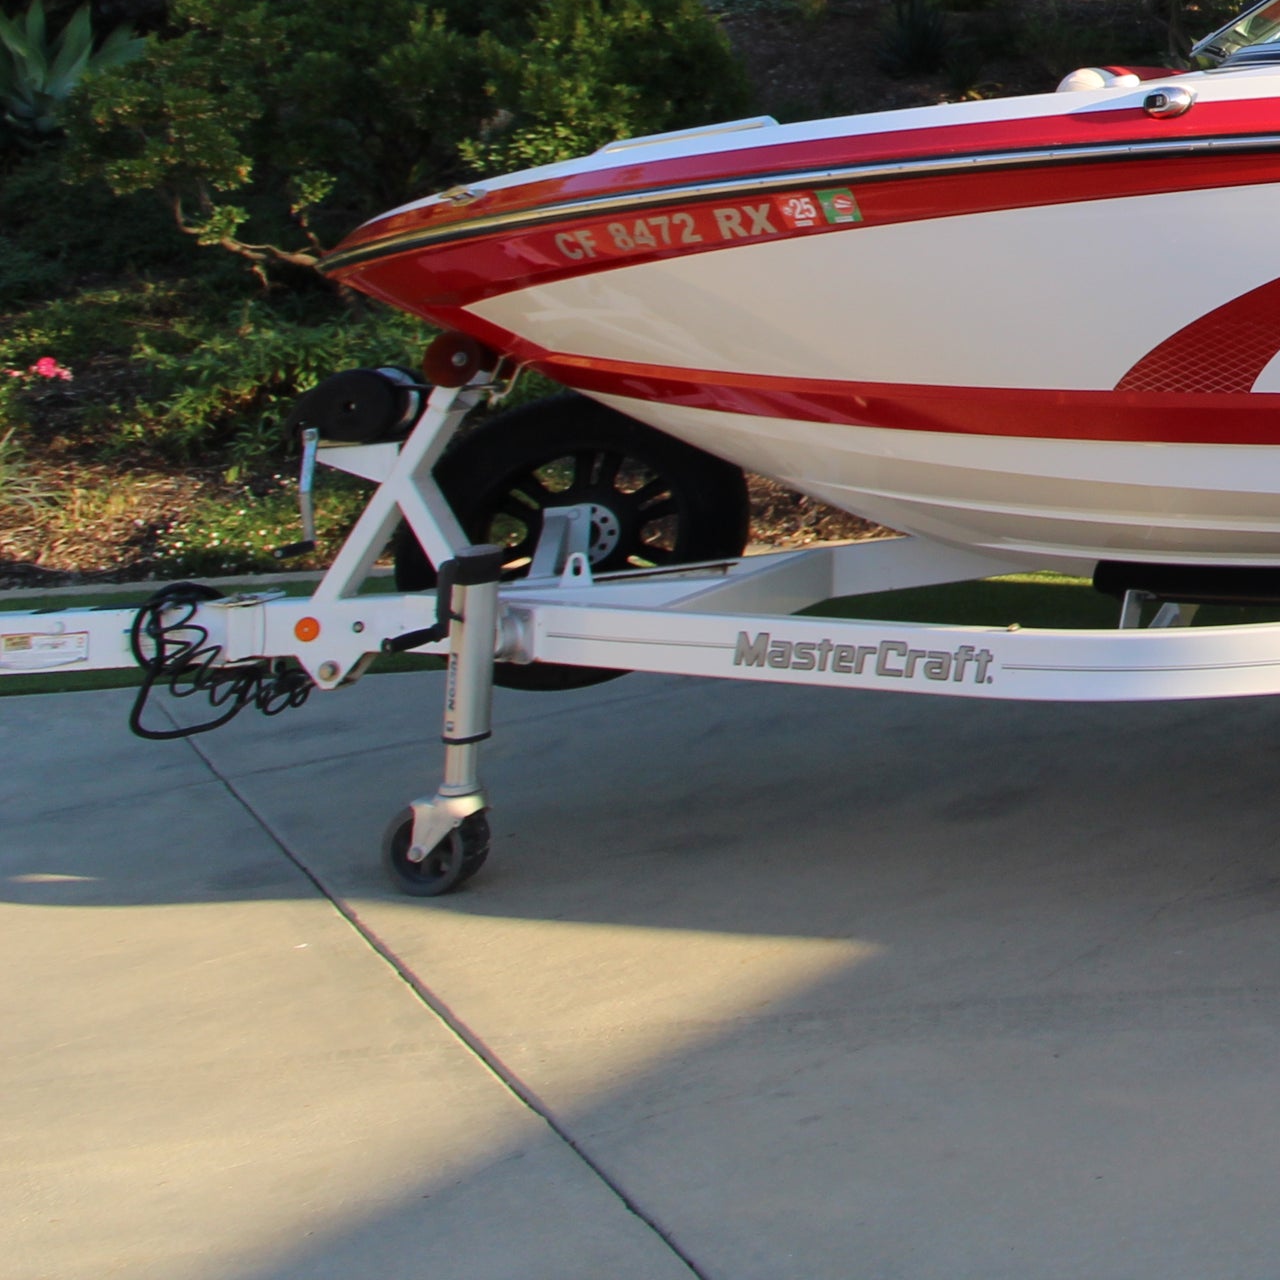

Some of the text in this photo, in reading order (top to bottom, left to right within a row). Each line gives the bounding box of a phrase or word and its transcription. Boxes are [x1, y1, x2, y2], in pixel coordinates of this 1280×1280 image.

[788, 197, 817, 219] 25
[554, 203, 778, 260] CF 8472 RX
